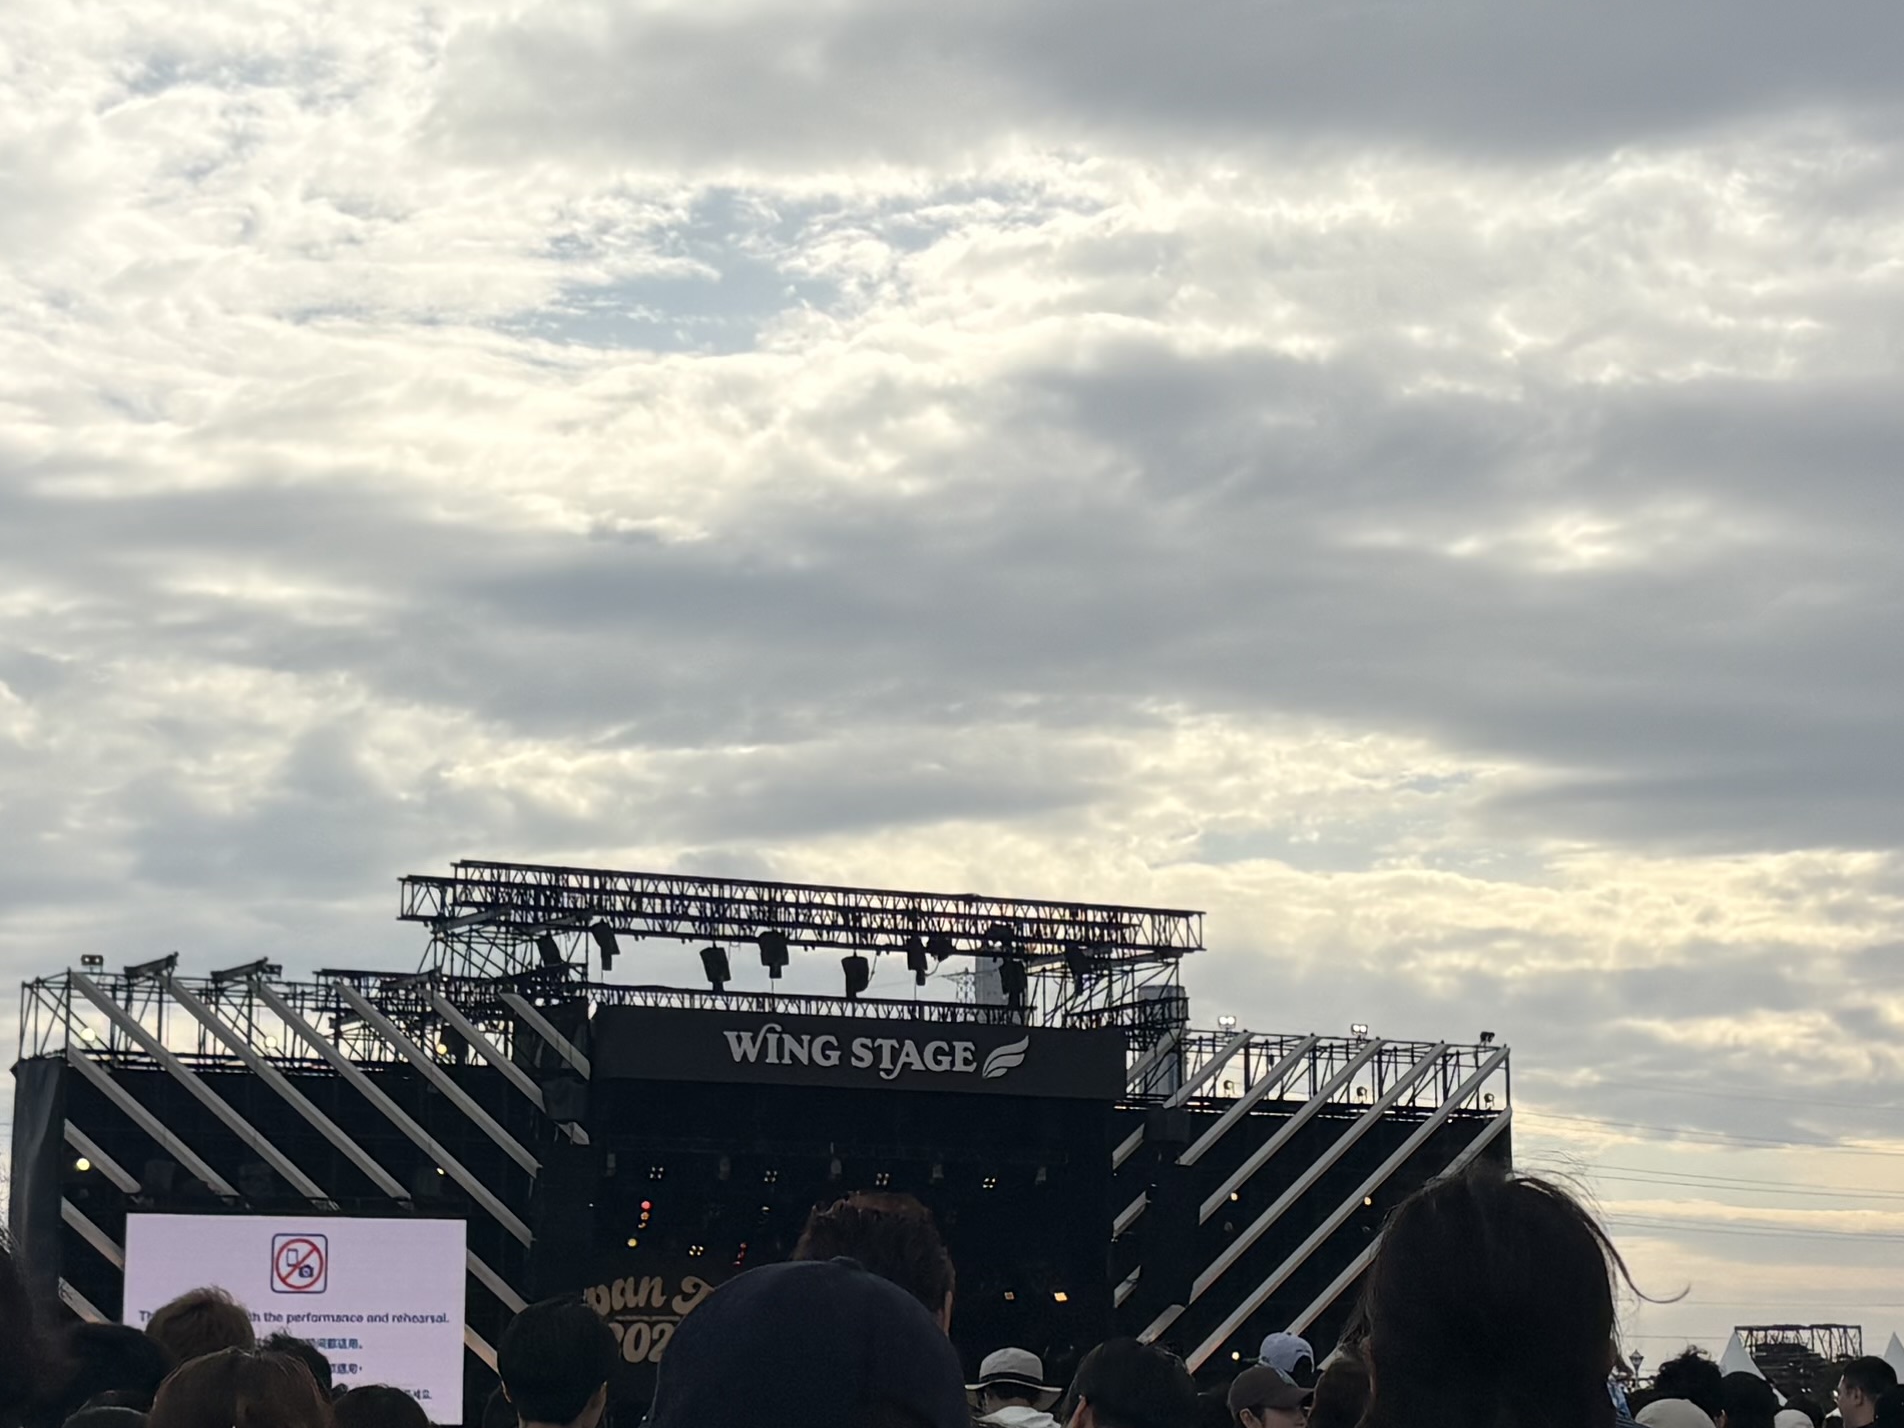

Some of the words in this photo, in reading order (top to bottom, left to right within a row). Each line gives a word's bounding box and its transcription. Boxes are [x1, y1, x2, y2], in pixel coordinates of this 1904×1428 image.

[723, 1023, 841, 1066] WING
[851, 1038, 977, 1080] STAGE
[263, 1311, 283, 1322] the
[286, 1312, 363, 1325] performance
[367, 1312, 389, 1323] and
